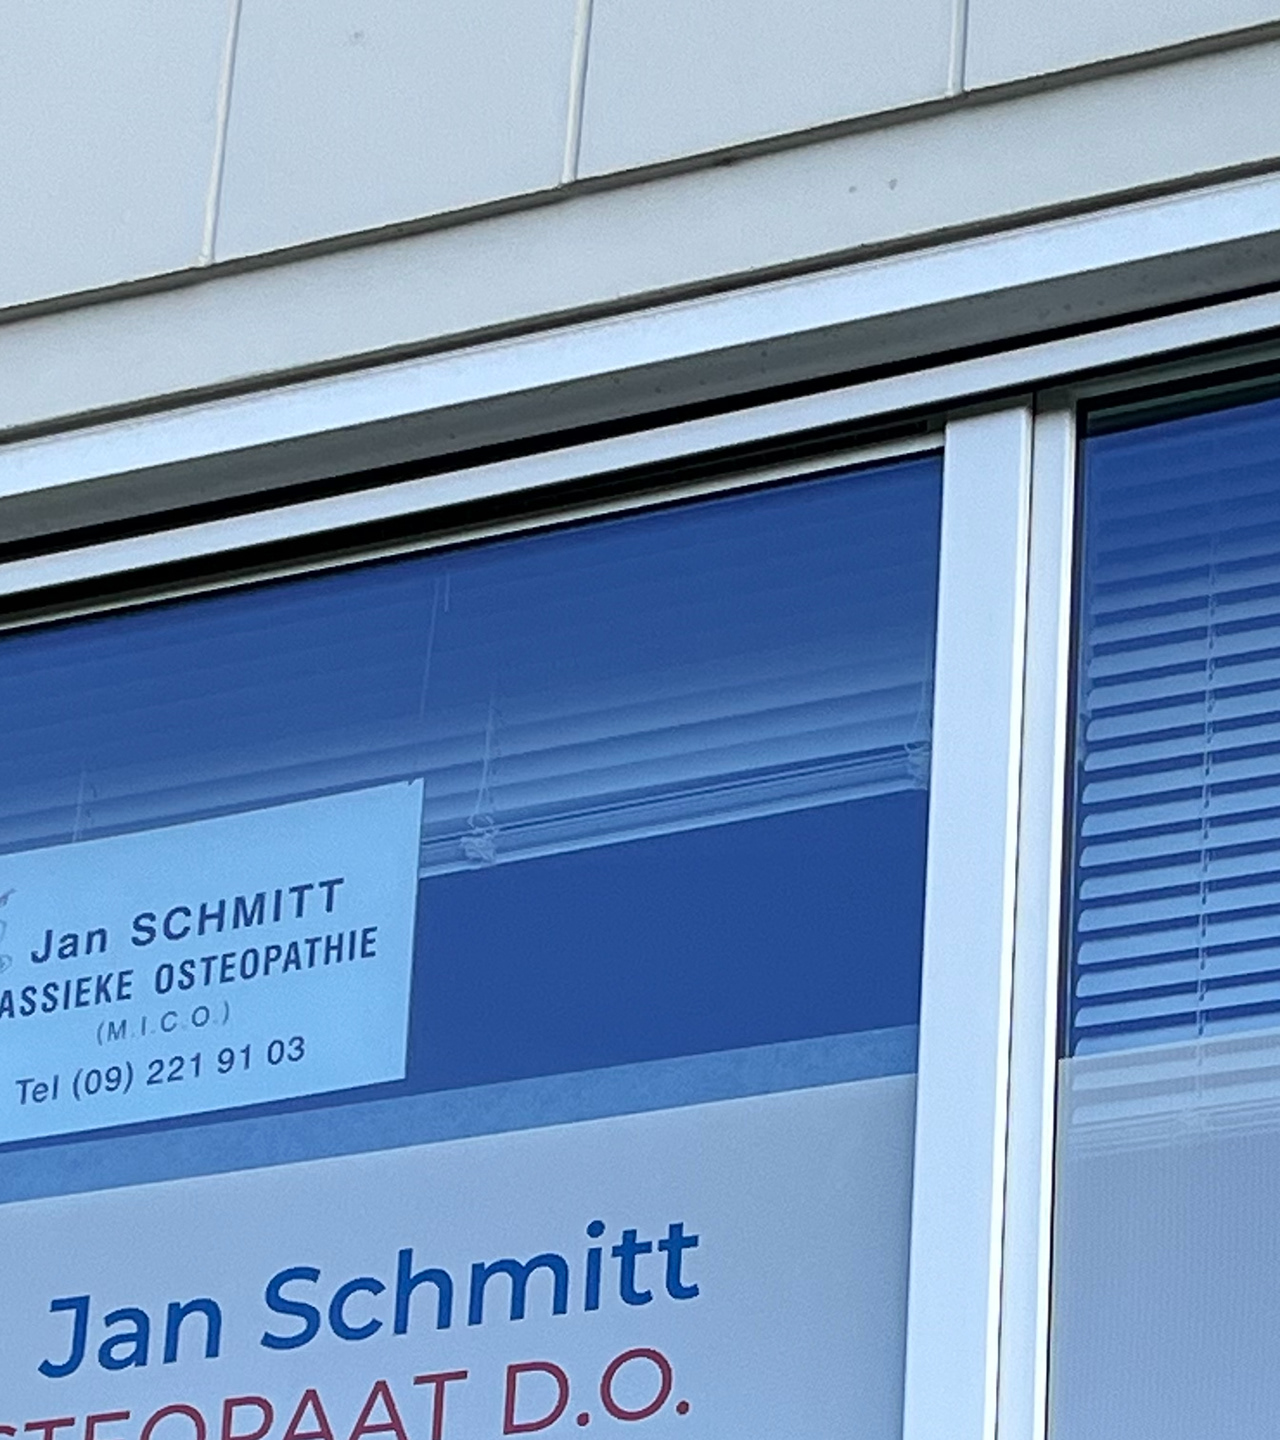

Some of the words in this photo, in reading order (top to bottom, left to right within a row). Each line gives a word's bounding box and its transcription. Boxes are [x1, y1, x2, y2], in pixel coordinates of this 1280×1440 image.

[31, 927, 108, 964] Jan
[131, 877, 344, 947] SCHMITT
[155, 926, 378, 994] OSTEOPATHIE
[16, 1074, 59, 1106] Tel
[72, 1061, 133, 1102] (09)
[147, 1052, 202, 1086] 221
[217, 1044, 251, 1074] 91
[267, 1036, 305, 1065] 03
[39, 1294, 223, 1379] Jan
[259, 1220, 700, 1351] Schmitt
[502, 1347, 691, 1435] D.O.
